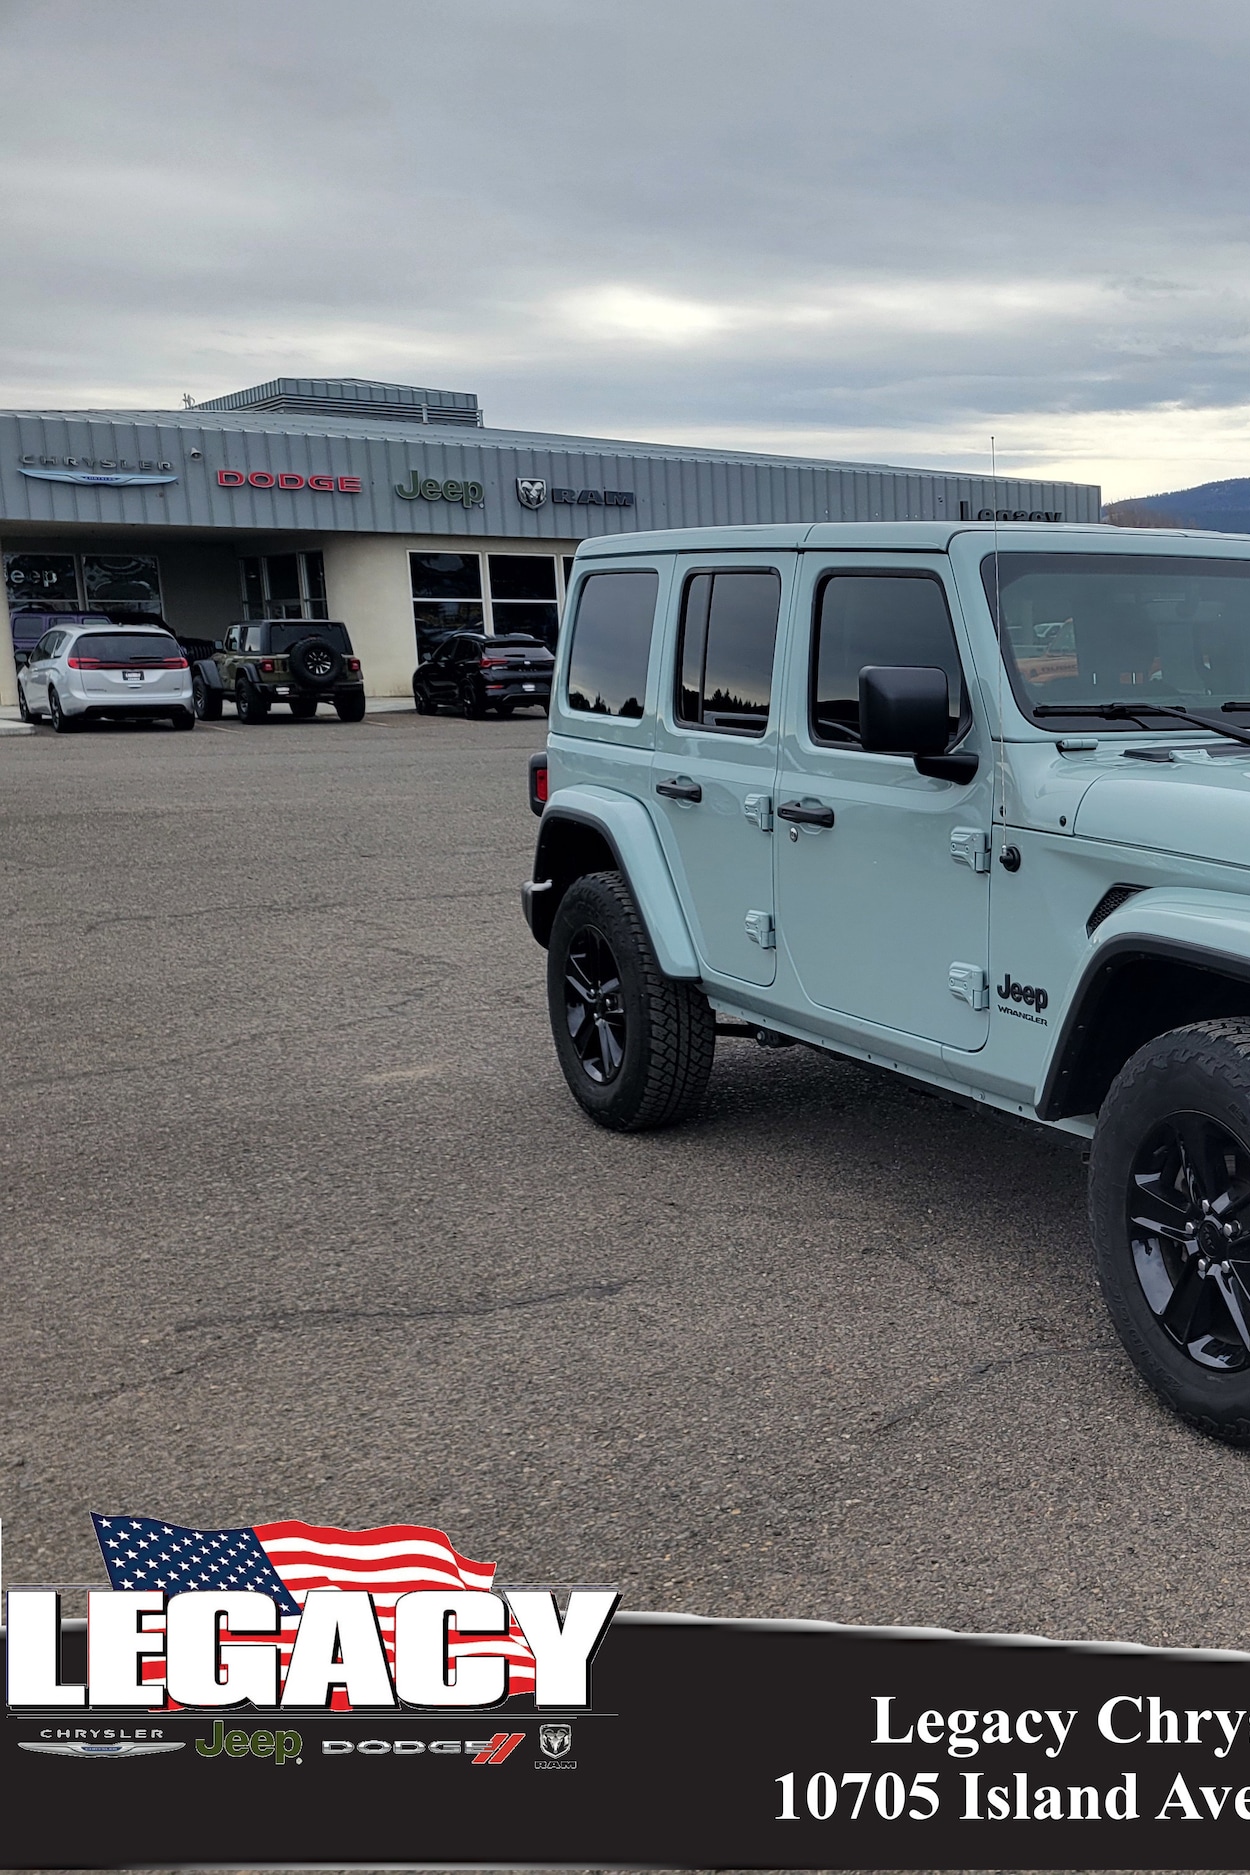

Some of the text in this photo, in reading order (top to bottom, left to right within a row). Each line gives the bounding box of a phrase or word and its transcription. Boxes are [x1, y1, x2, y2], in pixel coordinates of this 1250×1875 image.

[20, 454, 173, 471] CHRYSLER
[217, 469, 363, 494] DODGE
[395, 470, 485, 509] Jeep
[551, 488, 636, 506] RAM
[997, 973, 1049, 1014] Jeep
[997, 1004, 1048, 1027] WRANGLER
